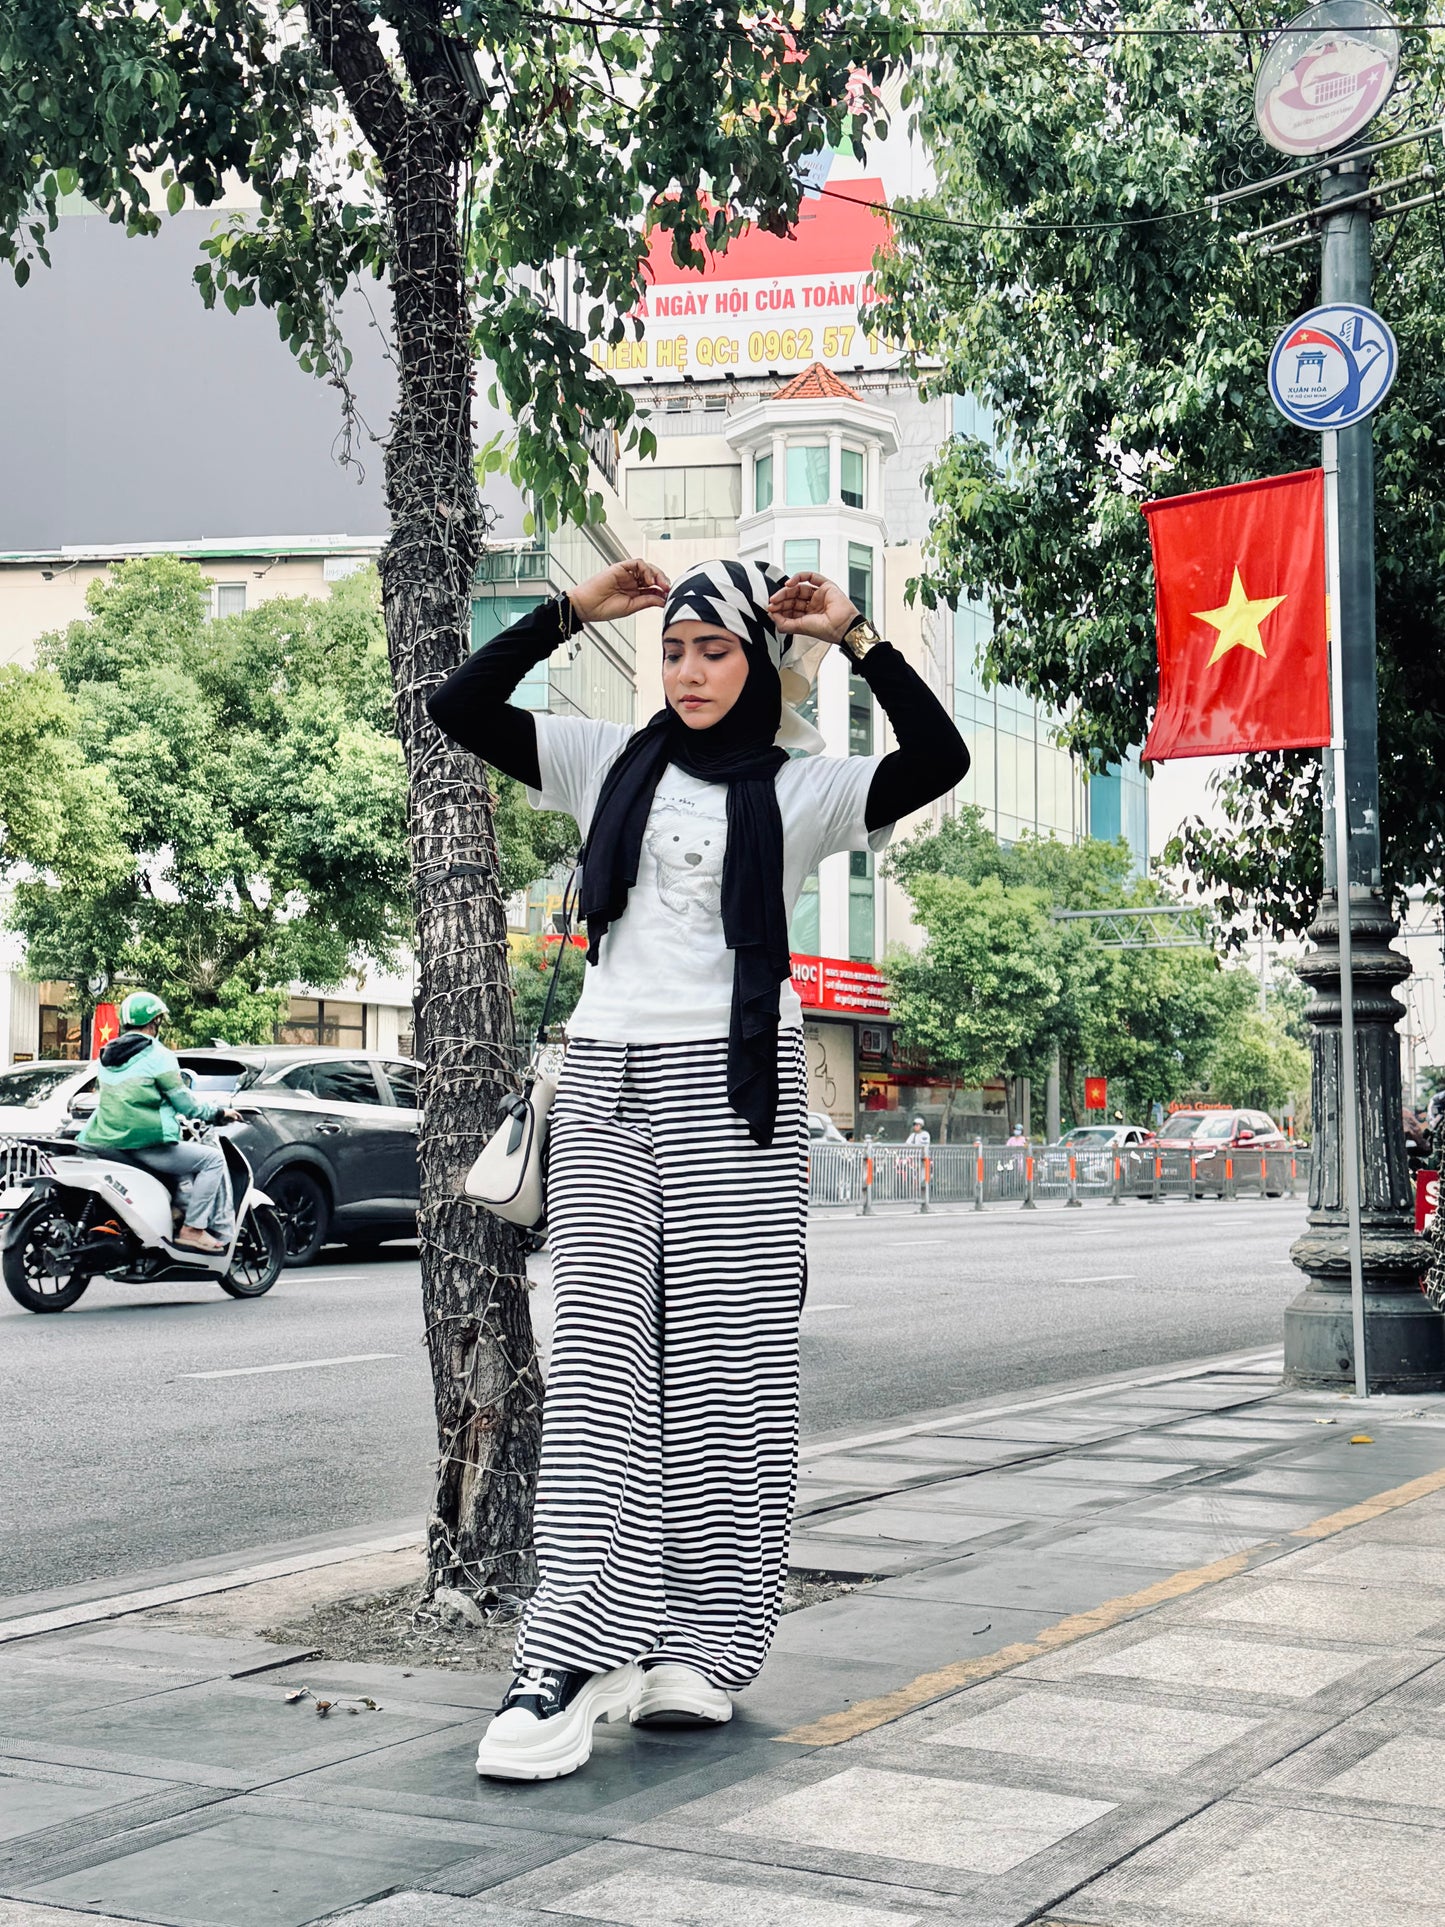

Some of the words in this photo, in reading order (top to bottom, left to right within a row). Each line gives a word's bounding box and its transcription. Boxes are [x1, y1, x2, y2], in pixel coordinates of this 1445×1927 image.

[655, 290, 709, 317] NGÀY
[715, 287, 748, 317] HỘI
[755, 280, 795, 312] CỦA
[802, 281, 855, 308] TOÀN
[656, 334, 688, 373] HỆ
[696, 335, 739, 367] QC:
[748, 327, 814, 363] 0962
[823, 325, 856, 358] 57
[791, 962, 818, 987] HỌC
